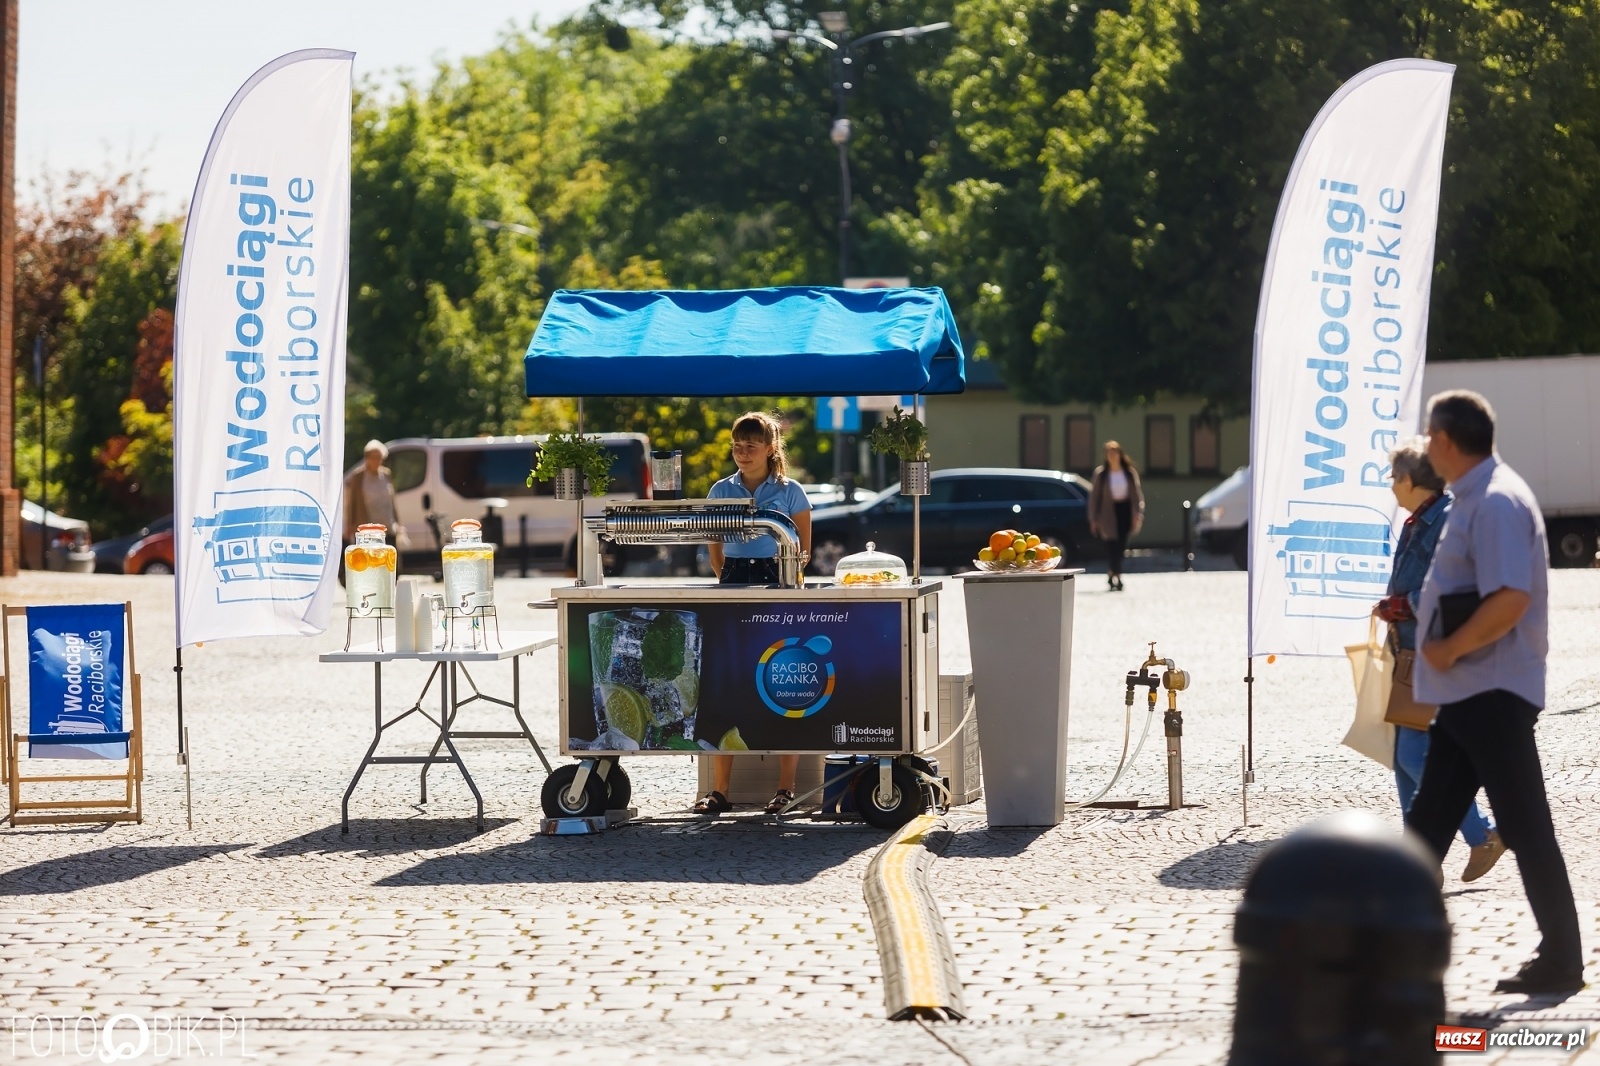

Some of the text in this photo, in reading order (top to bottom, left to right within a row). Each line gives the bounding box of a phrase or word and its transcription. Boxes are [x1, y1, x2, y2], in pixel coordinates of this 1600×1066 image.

[226, 174, 277, 481] Wodociągi
[278, 176, 320, 472] Raciborskie
[1303, 180, 1366, 490] Wodociągi
[1361, 187, 1406, 488] Raciborskie
[781, 612, 794, 625] ją
[797, 614, 807, 623] w
[809, 611, 849, 623] kranie!
[61, 632, 86, 713] Wodociągi
[86, 630, 105, 714] Raciborskie
[771, 662, 818, 673] RACIBO
[771, 674, 819, 684] RZANKA
[849, 726, 894, 737] Wodociągi
[850, 735, 895, 743] Raciborskie
